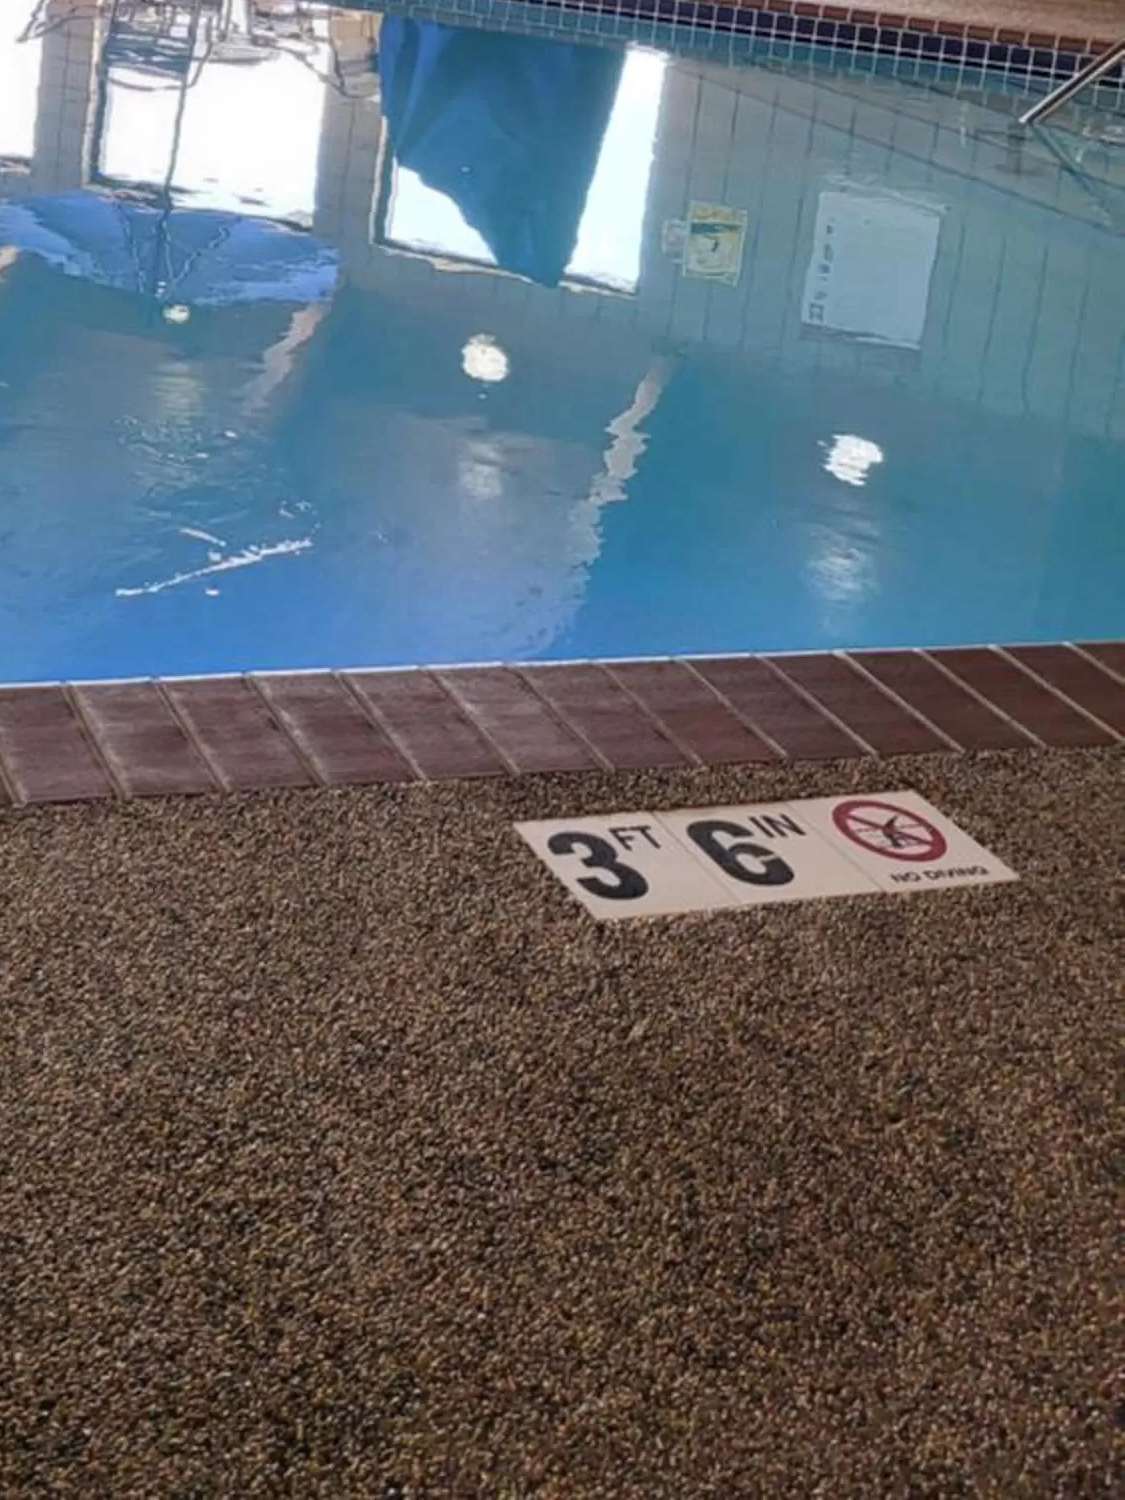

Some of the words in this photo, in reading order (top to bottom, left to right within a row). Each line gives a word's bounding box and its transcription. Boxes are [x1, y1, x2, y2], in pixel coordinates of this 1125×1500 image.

[547, 831, 649, 900] 3
[608, 825, 661, 852] FT
[686, 819, 794, 886] 6
[748, 813, 806, 838] IN
[890, 871, 921, 882] NO
[922, 865, 988, 880] DIVING
